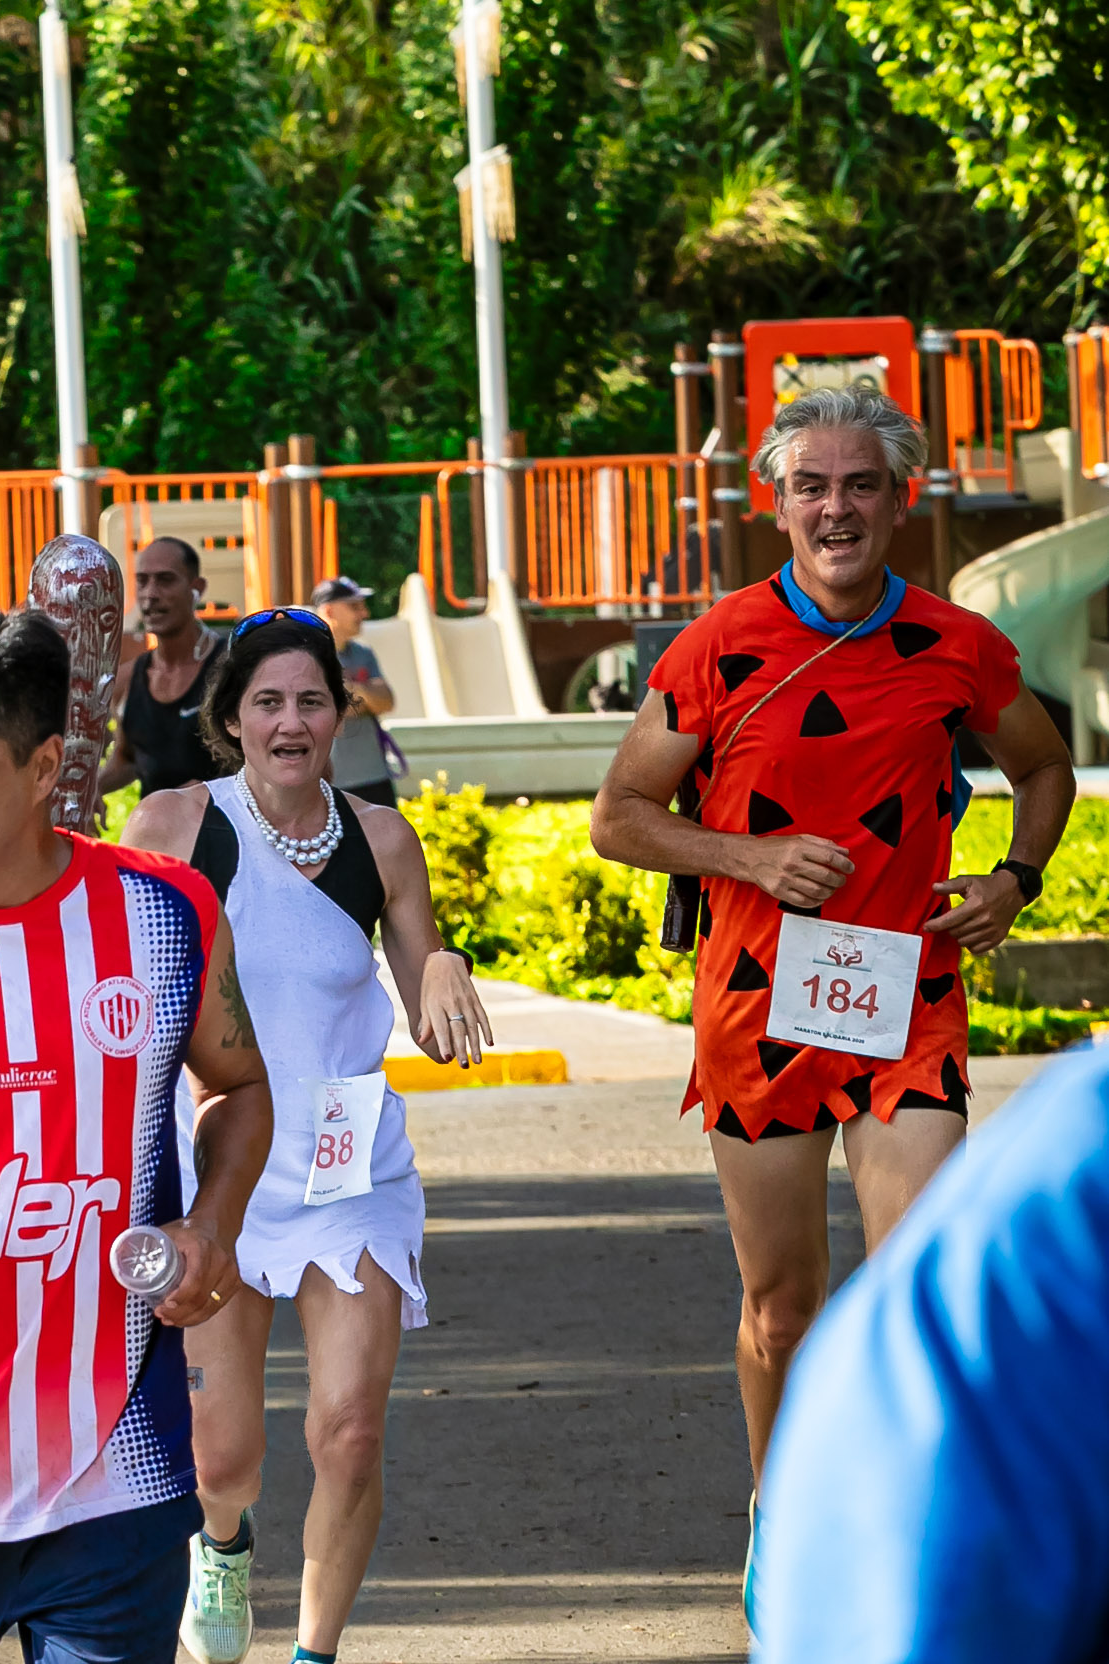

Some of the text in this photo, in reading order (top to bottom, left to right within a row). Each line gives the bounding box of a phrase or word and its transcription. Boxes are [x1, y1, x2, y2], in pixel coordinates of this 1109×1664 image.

[108, 979, 145, 994] ATLETISMO
[803, 974, 879, 1019] 184
[794, 1026, 822, 1036] MARATON
